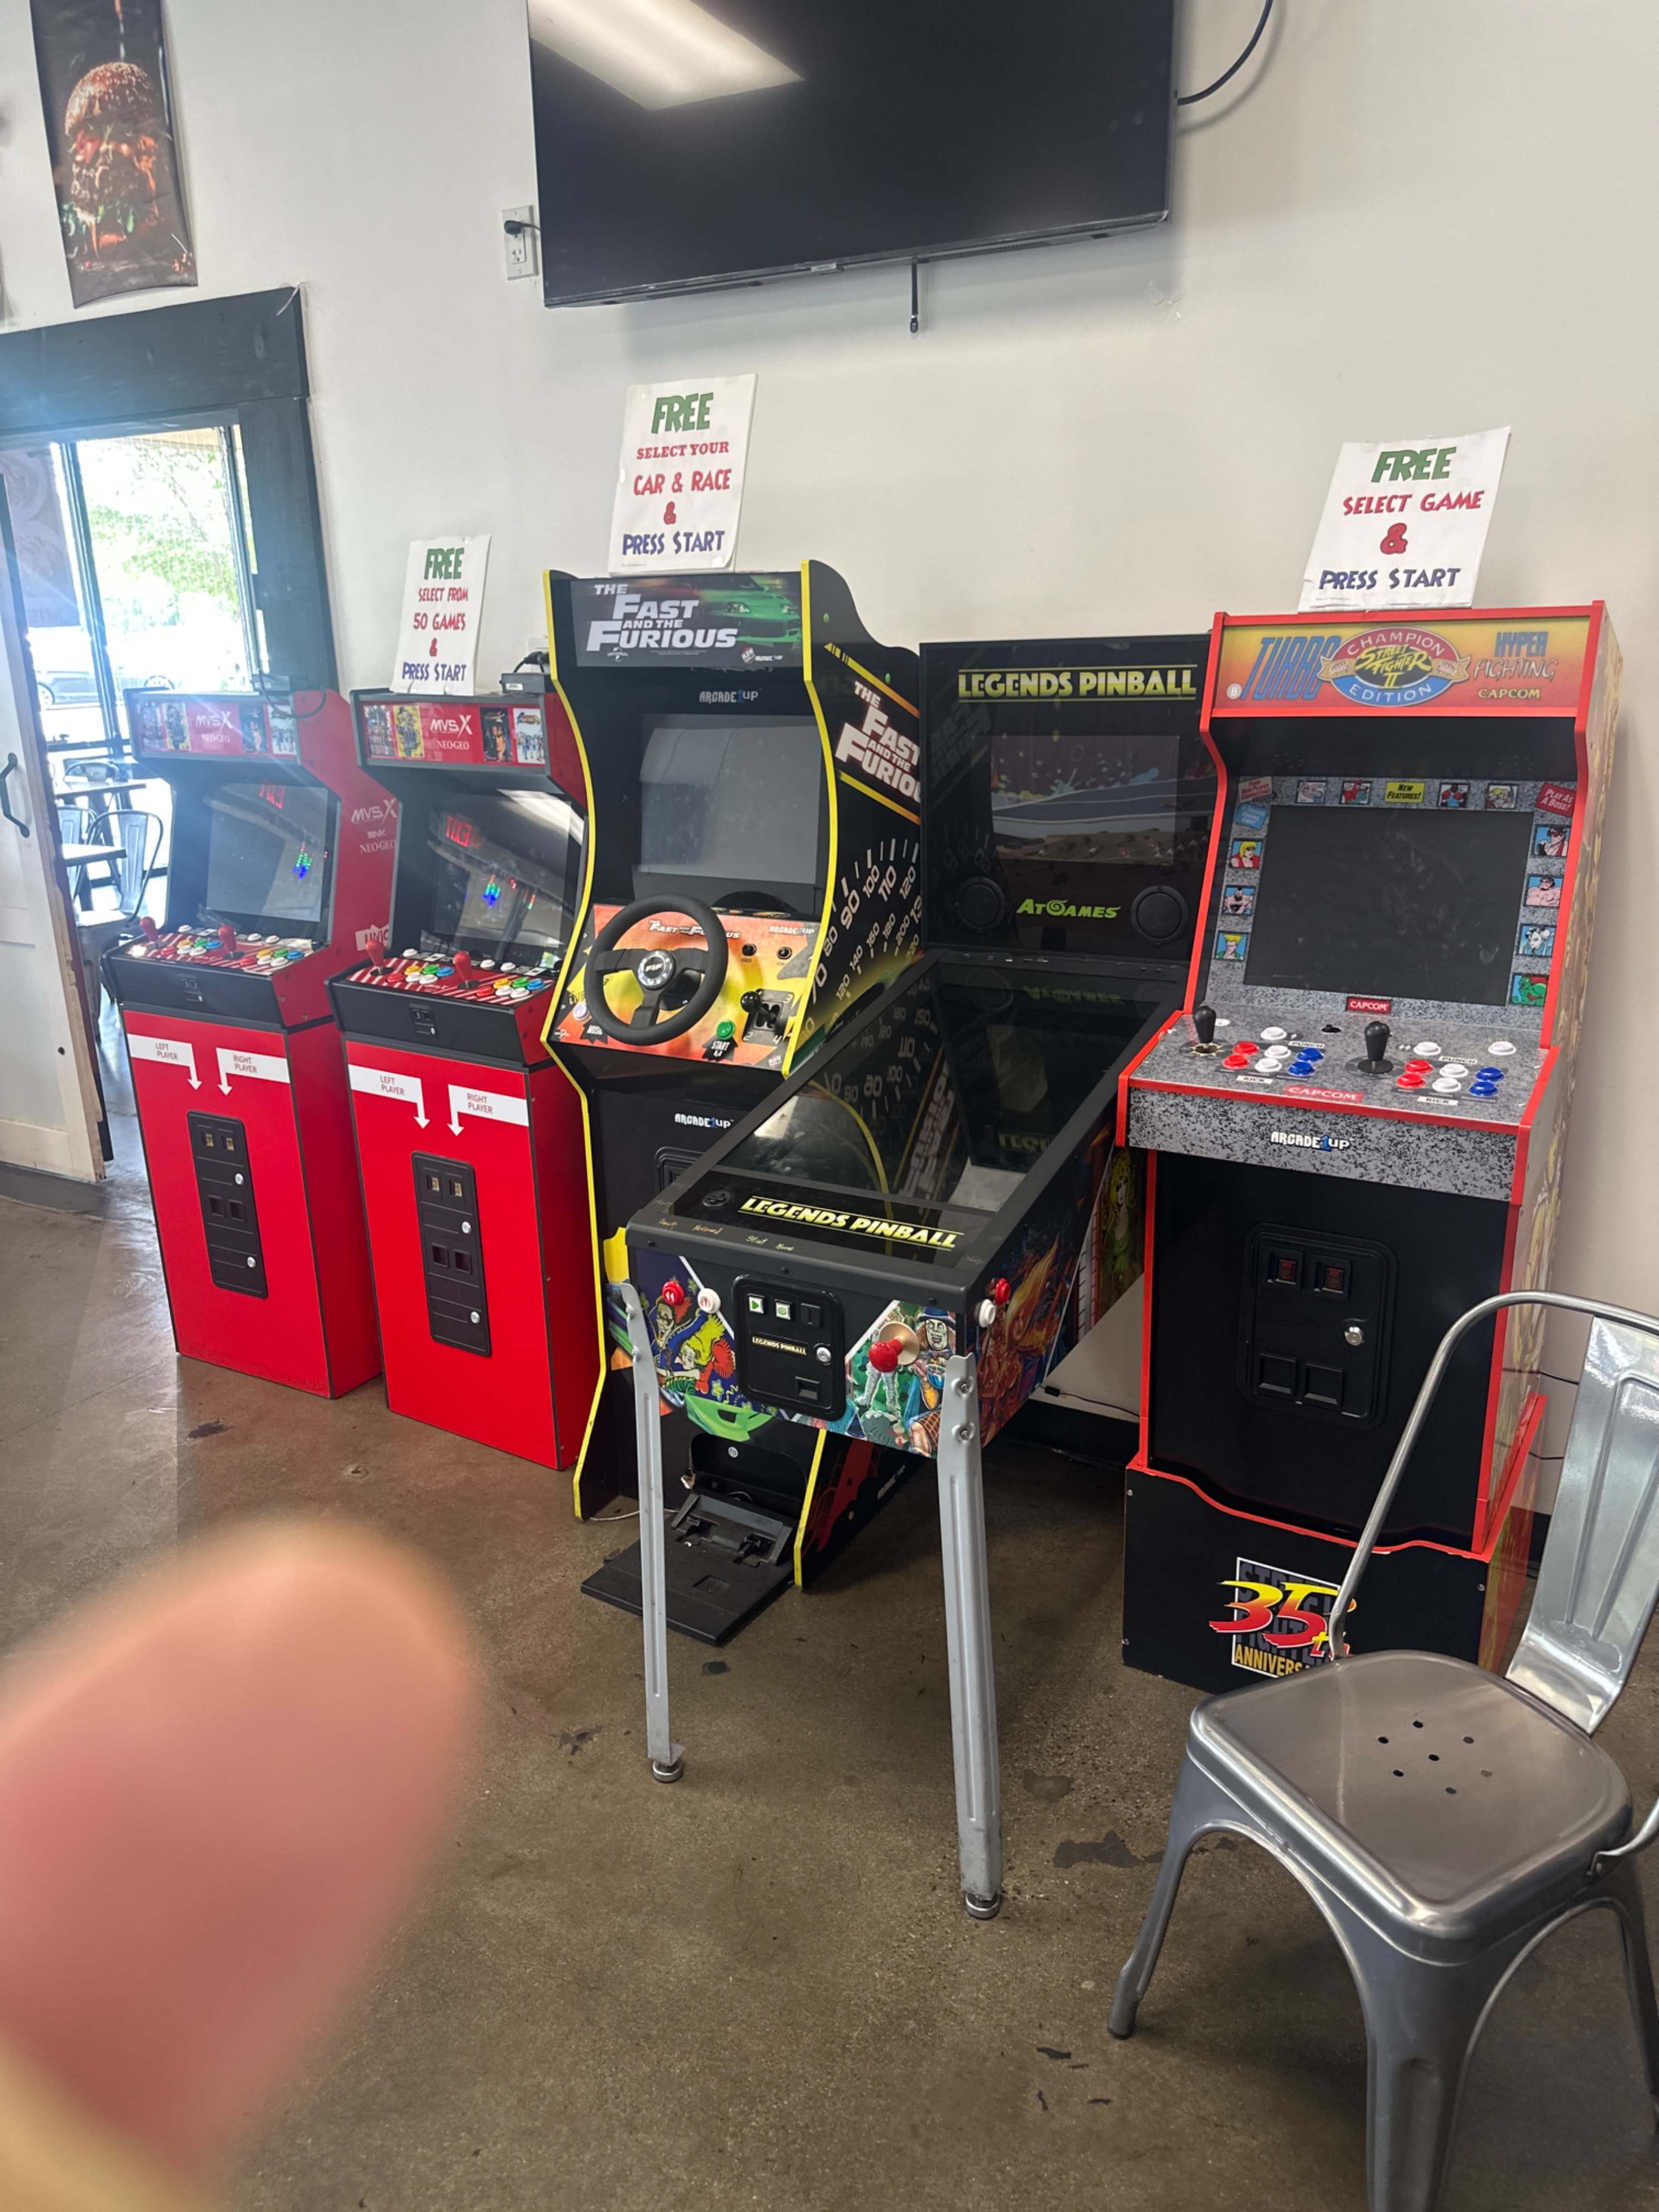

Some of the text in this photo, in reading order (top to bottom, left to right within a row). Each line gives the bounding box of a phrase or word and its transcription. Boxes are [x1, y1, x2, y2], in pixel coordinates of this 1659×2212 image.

[651, 392, 714, 434] FREE
[637, 441, 729, 460] SELECT YOUR
[1371, 446, 1456, 483] FREE
[634, 469, 732, 495] CAR & RACE
[663, 501, 676, 524] &
[1343, 490, 1484, 515] SELECT GAME
[622, 531, 725, 555] PRESS START
[1380, 523, 1408, 555] &
[424, 548, 464, 580] FREE
[594, 584, 628, 594] THE
[1319, 568, 1460, 590] PRESS START
[419, 587, 468, 602] SELECT FROM
[612, 594, 699, 620] FAST
[413, 613, 466, 631] 50 GAMES
[623, 620, 683, 628] AND THE
[587, 620, 737, 651] FURIOUS
[1347, 632, 1444, 657] CHAMPION
[1494, 632, 1548, 657] HYPER
[429, 638, 438, 657] &
[1356, 644, 1409, 670] STREET
[402, 662, 467, 681] PRESS START
[1239, 636, 1342, 700] TURBO
[1362, 650, 1433, 675] FIGHTER
[1473, 658, 1558, 682] FIGHTING
[958, 670, 1196, 698] LEGENDS PINBALL
[1384, 672, 1402, 689] II
[854, 680, 880, 709] THE
[1348, 683, 1432, 704] EDITION
[1478, 689, 1540, 699] CAPCOM
[862, 704, 920, 766] FAST
[868, 739, 911, 772] AND THE
[1387, 791, 1421, 799] FEATURES!
[1541, 796, 1571, 811] A BOSS!
[1545, 788, 1573, 803] PLAY AS
[368, 829, 386, 839] SNK
[863, 864, 880, 899] 100
[878, 865, 897, 902] 110
[899, 865, 916, 900] 120
[840, 890, 860, 930] 90
[650, 923, 679, 932] FAST
[866, 922, 880, 948] 160
[882, 913, 896, 939] 180
[896, 914, 910, 944] 200
[823, 925, 838, 957] 80
[906, 933, 920, 963] 220
[849, 945, 863, 971] 140
[836, 973, 850, 1001] 120
[783, 995, 793, 1004] 3
[1350, 1001, 1386, 1011] CAPCOM
[156, 1042, 168, 1051] LEFT
[711, 1041, 730, 1051] START
[743, 1032, 753, 1040] 2
[773, 1035, 782, 1045] 4
[157, 1051, 178, 1061] PLAYER
[233, 1055, 252, 1064] RIGHT
[235, 1063, 257, 1073] PLAYER
[380, 1075, 395, 1084] LEFT
[381, 1084, 404, 1095] PLAYER
[467, 1093, 487, 1104] RIGHT
[1289, 1086, 1357, 1100] CAPCOM
[468, 1102, 493, 1113] PLAYER
[740, 1198, 957, 1250] LEGENDS PINBALL
[752, 1336, 807, 1356] LEGENDS PINBALL
